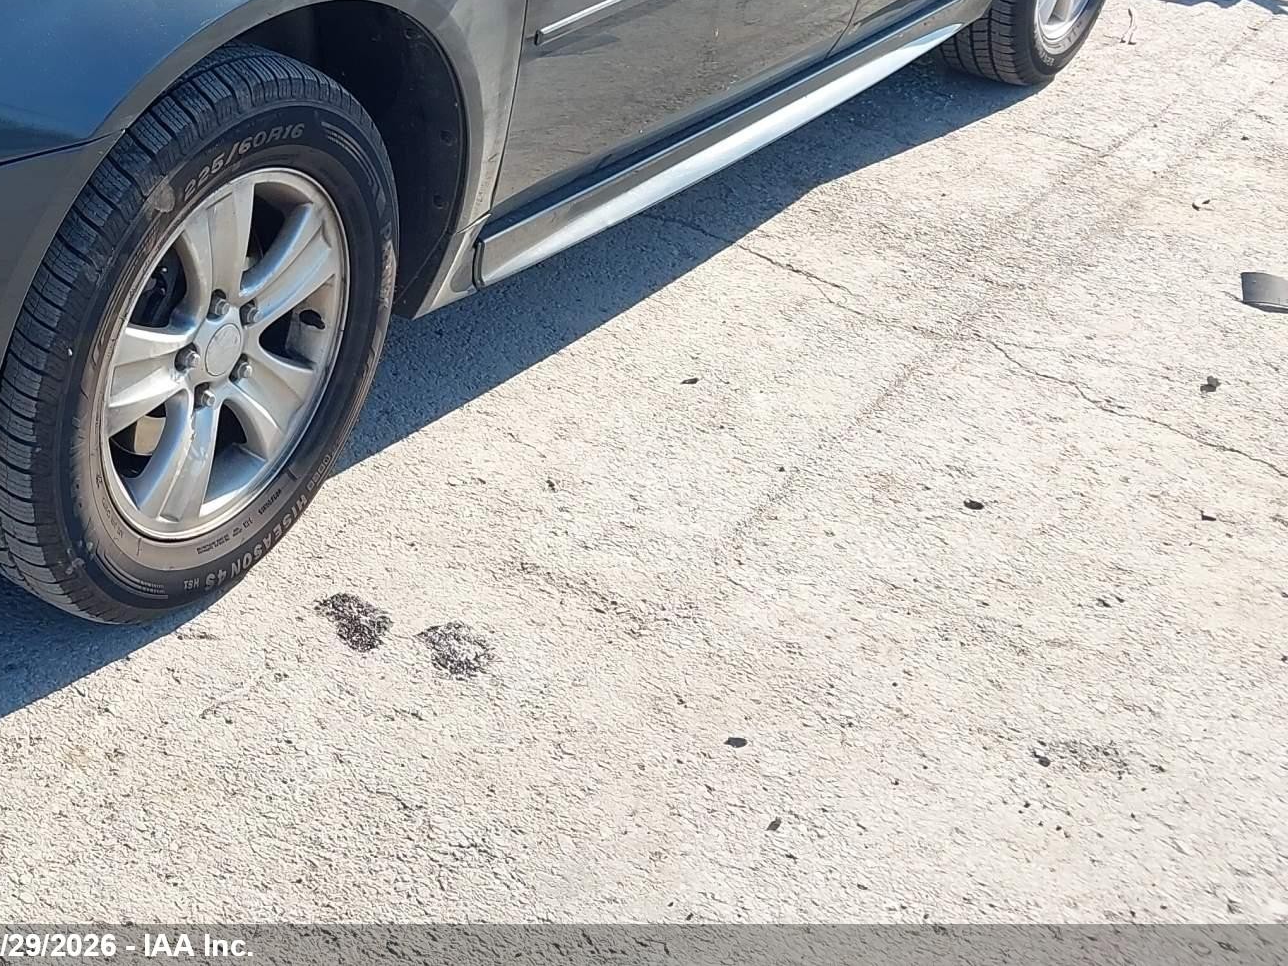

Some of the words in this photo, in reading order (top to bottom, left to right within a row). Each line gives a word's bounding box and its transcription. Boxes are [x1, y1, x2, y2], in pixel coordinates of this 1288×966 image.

[183, 122, 305, 202] 225/60R16
[229, 493, 308, 579] HISEASON
[203, 569, 228, 591] 4S
